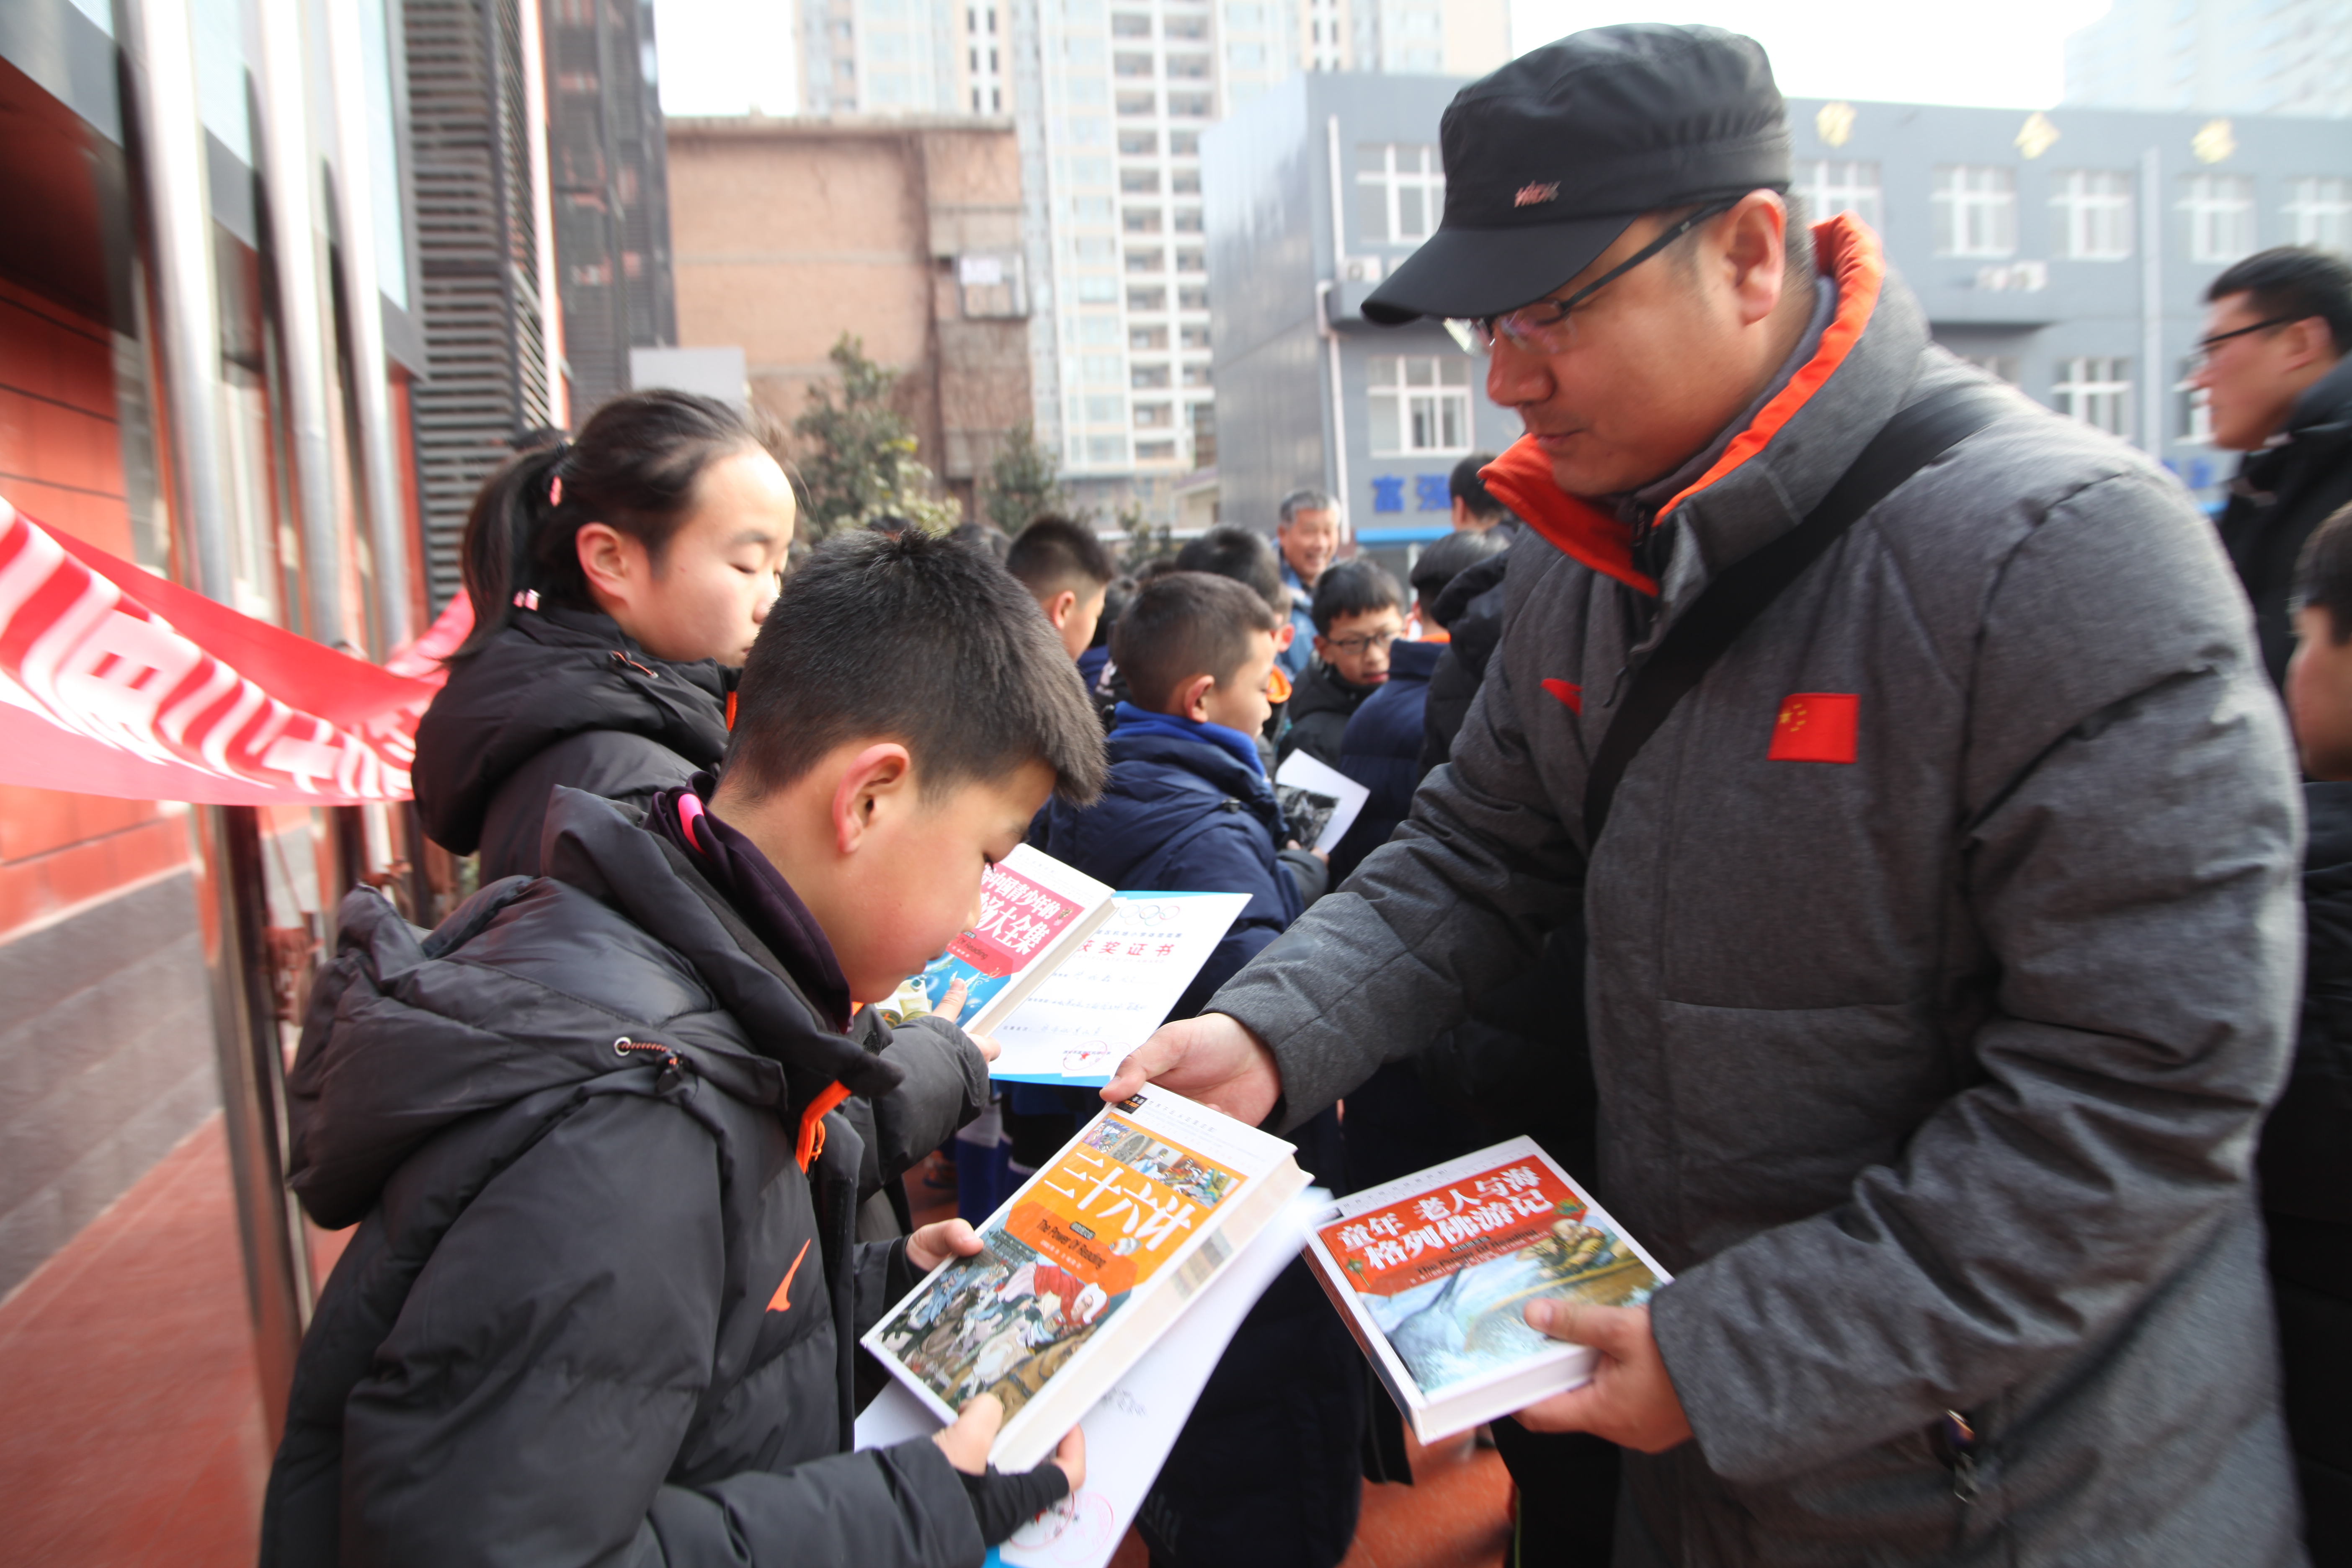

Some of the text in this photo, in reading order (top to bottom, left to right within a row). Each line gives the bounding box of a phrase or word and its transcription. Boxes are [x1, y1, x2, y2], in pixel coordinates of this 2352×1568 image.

[965, 942, 988, 960] Reading
[1044, 1152, 1196, 1251] 三十六计
[1336, 1212, 1405, 1253] 童年
[1412, 1166, 1542, 1221] 老人与海
[1363, 1189, 1554, 1271] 格列佛游记
[1037, 1219, 1050, 1233] The
[1048, 1226, 1071, 1245] Power
[1075, 1244, 1106, 1270] Reading
[1416, 1264, 1438, 1274] The
[1438, 1251, 1474, 1266] Power
[1490, 1229, 1538, 1248] Reading
